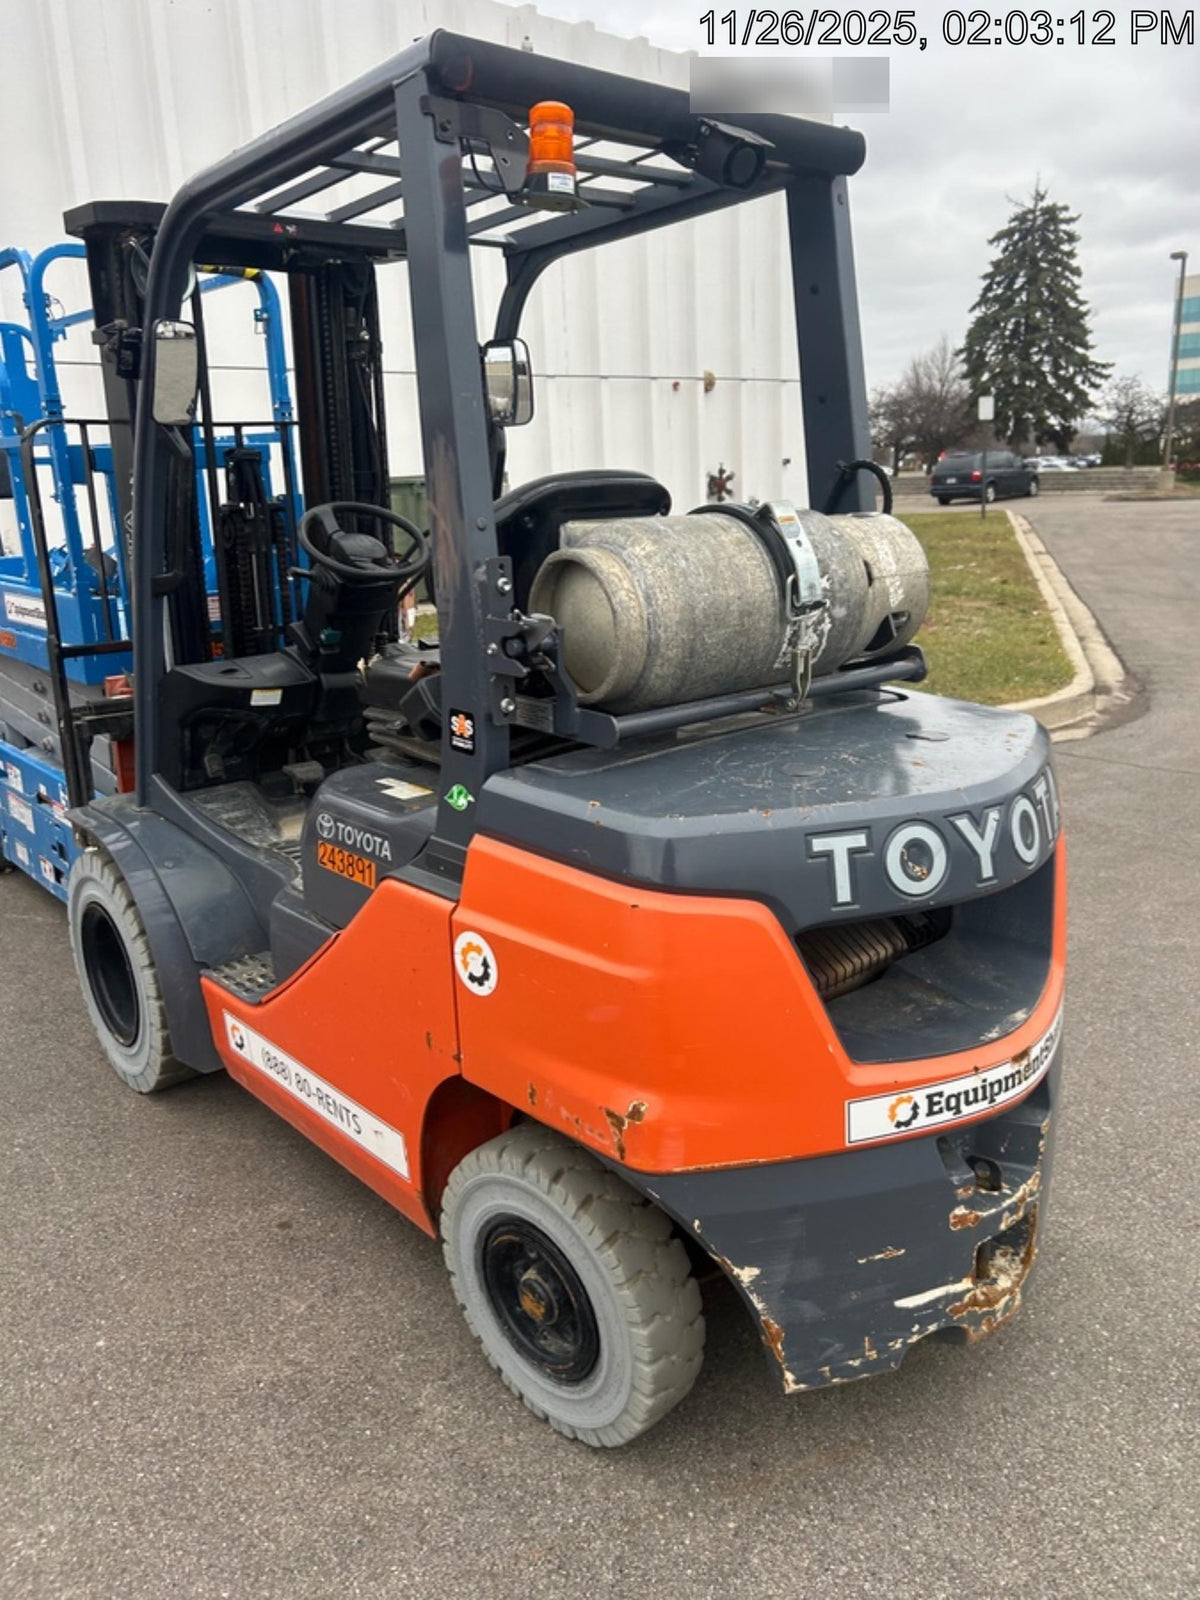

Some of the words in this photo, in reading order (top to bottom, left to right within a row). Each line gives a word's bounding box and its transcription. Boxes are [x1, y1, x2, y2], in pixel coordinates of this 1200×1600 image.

[318, 841, 373, 887] 243891
[336, 821, 392, 862] TOYOTA
[261, 1047, 293, 1087] (888)
[294, 1072, 363, 1136] 80-RENTS
